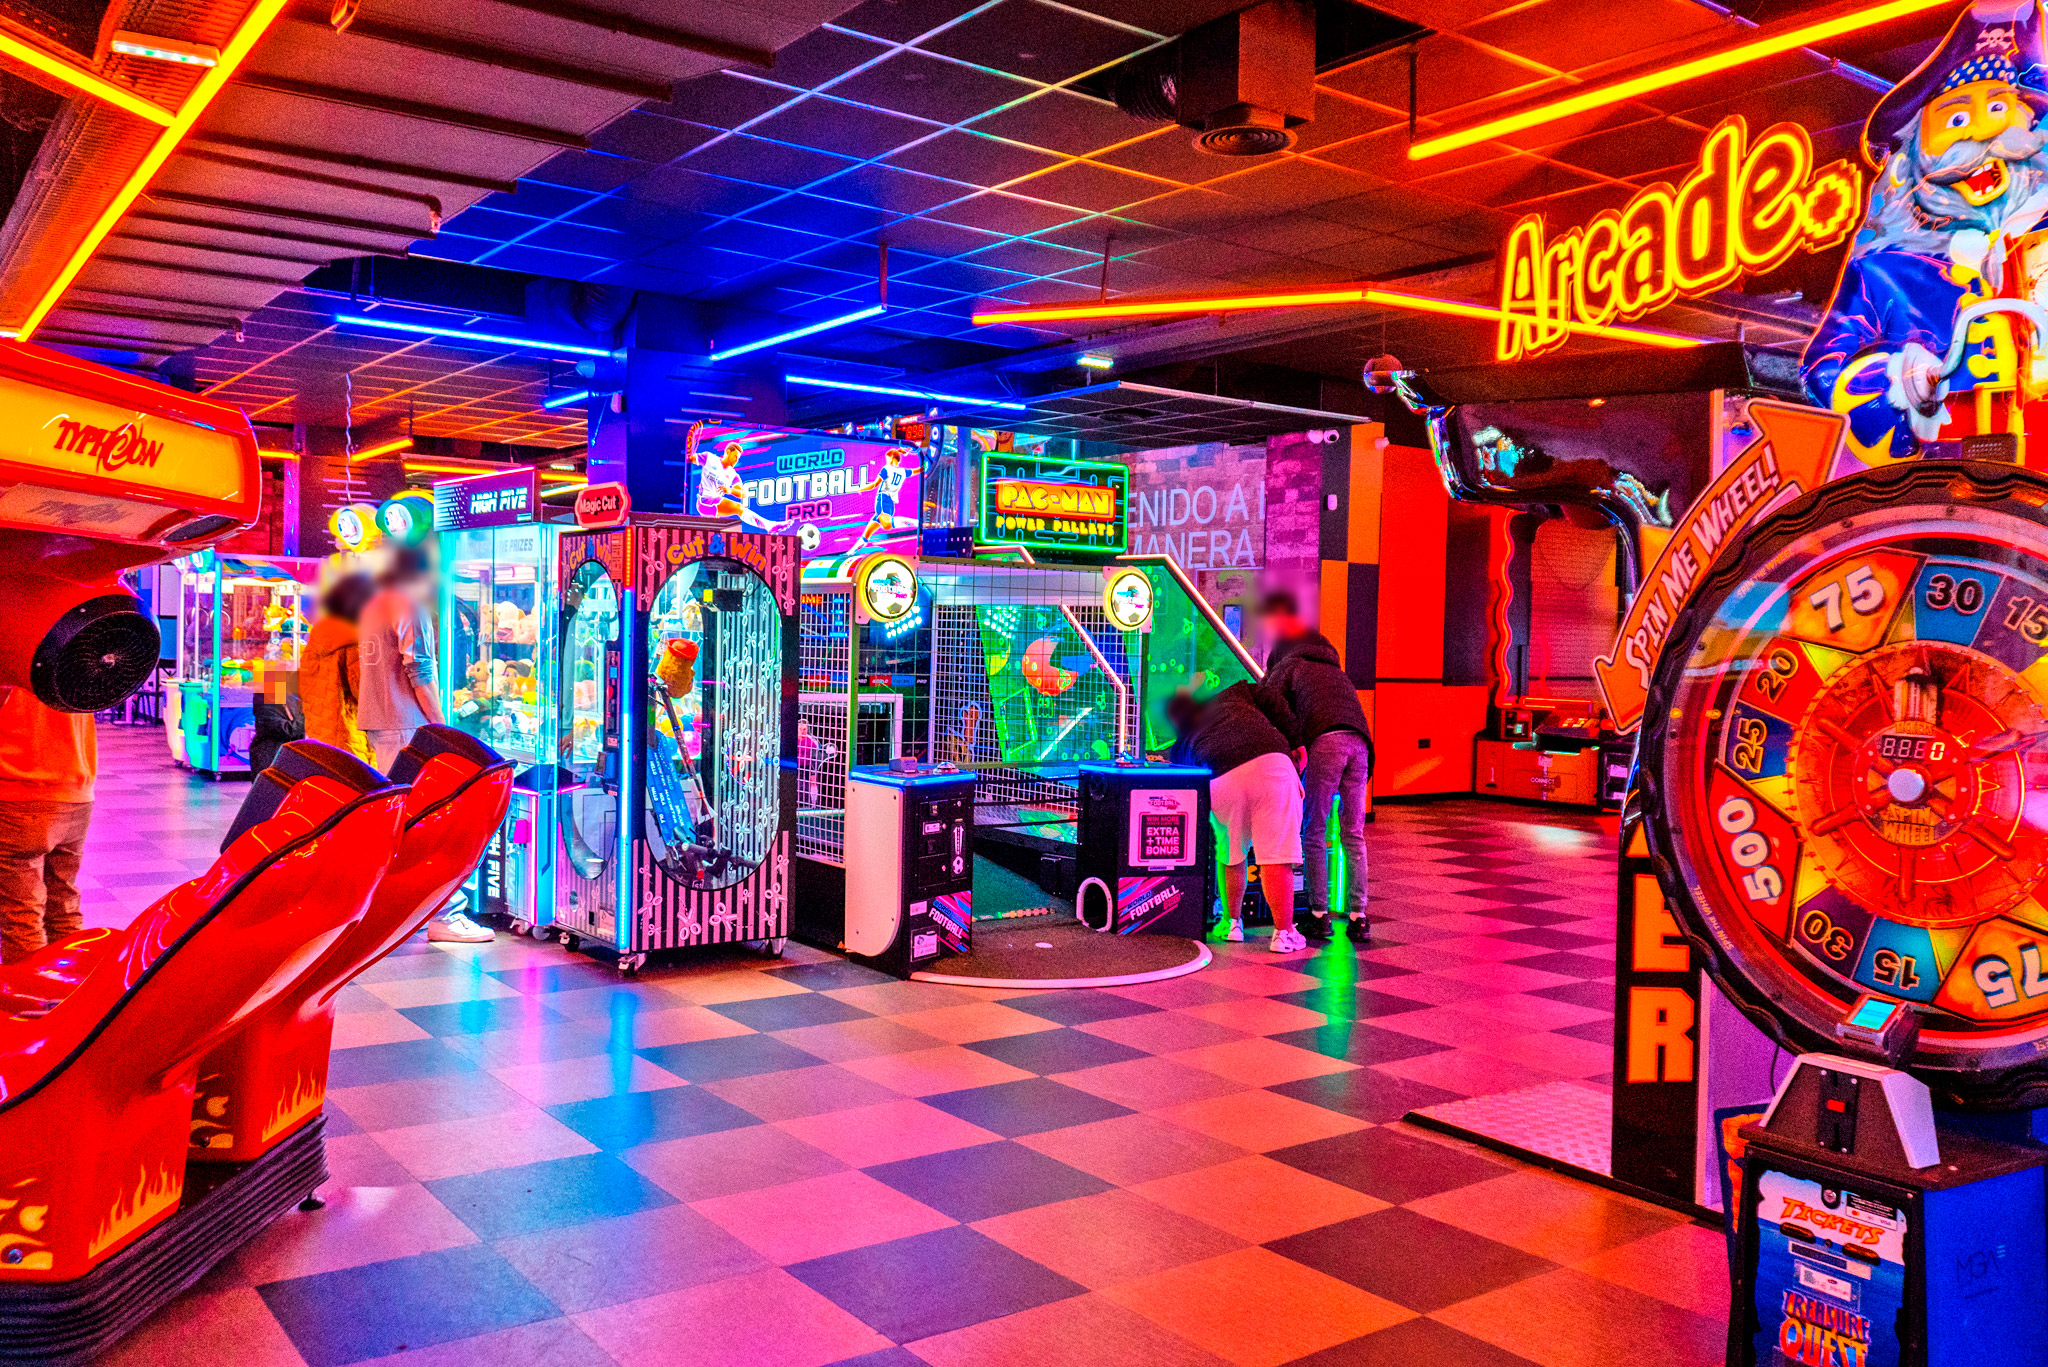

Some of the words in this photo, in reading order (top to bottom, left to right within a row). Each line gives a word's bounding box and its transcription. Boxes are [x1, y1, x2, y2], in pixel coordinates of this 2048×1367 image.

[777, 448, 844, 473] WORLD
[891, 471, 901, 486] 10
[470, 491, 498, 514] HIGH
[500, 487, 528, 511] FIVE
[579, 497, 601, 515] Magic
[601, 495, 617, 511] Cut
[741, 465, 871, 508] FOOTBALL
[1002, 483, 1111, 515] PAC-MAN
[1128, 485, 1217, 528] ENIDO
[1225, 483, 1249, 522] A
[785, 499, 832, 521] PRO
[995, 515, 1046, 532] POWER
[1053, 519, 1115, 537] PELLETS
[509, 538, 534, 552] PRIZES
[569, 540, 586, 570] Cut
[666, 535, 705, 565] Cut
[709, 533, 725, 555] &
[730, 536, 767, 571] Win
[1625, 590, 1670, 691] SPIN
[1661, 540, 1699, 611] ME
[1692, 444, 1780, 559] WHEEL!
[1736, 577, 1755, 599] SPIN
[1753, 566, 1767, 581] THE
[1764, 547, 1794, 571] WHEEL
[801, 595, 823, 605] IME
[1808, 564, 1885, 634] 75
[1926, 573, 1985, 615] 30
[2004, 595, 2048, 644] 15
[1755, 647, 1799, 704] 20
[1732, 717, 1768, 774] 25
[1886, 802, 1932, 823] SPIN
[1145, 846, 1180, 856] BONUS
[1146, 827, 1180, 837] EXTRA
[1718, 797, 1784, 901] 500
[1882, 820, 1935, 846] WHEEL
[487, 860, 501, 899] FIVE
[1129, 884, 1180, 921] FOOTBALL
[1694, 884, 1712, 916] WHEEL
[928, 907, 964, 939] FOOTBALL
[1716, 929, 1735, 950] SPIN
[1801, 909, 1854, 961] 30
[1625, 820, 1695, 1083] ER
[1873, 949, 1921, 991] 15
[1972, 943, 2048, 1009] 75
[1780, 1196, 1885, 1246] TICKETS
[1782, 1289, 1873, 1345] TREASURE
[1779, 1317, 1869, 1367] QUEST
